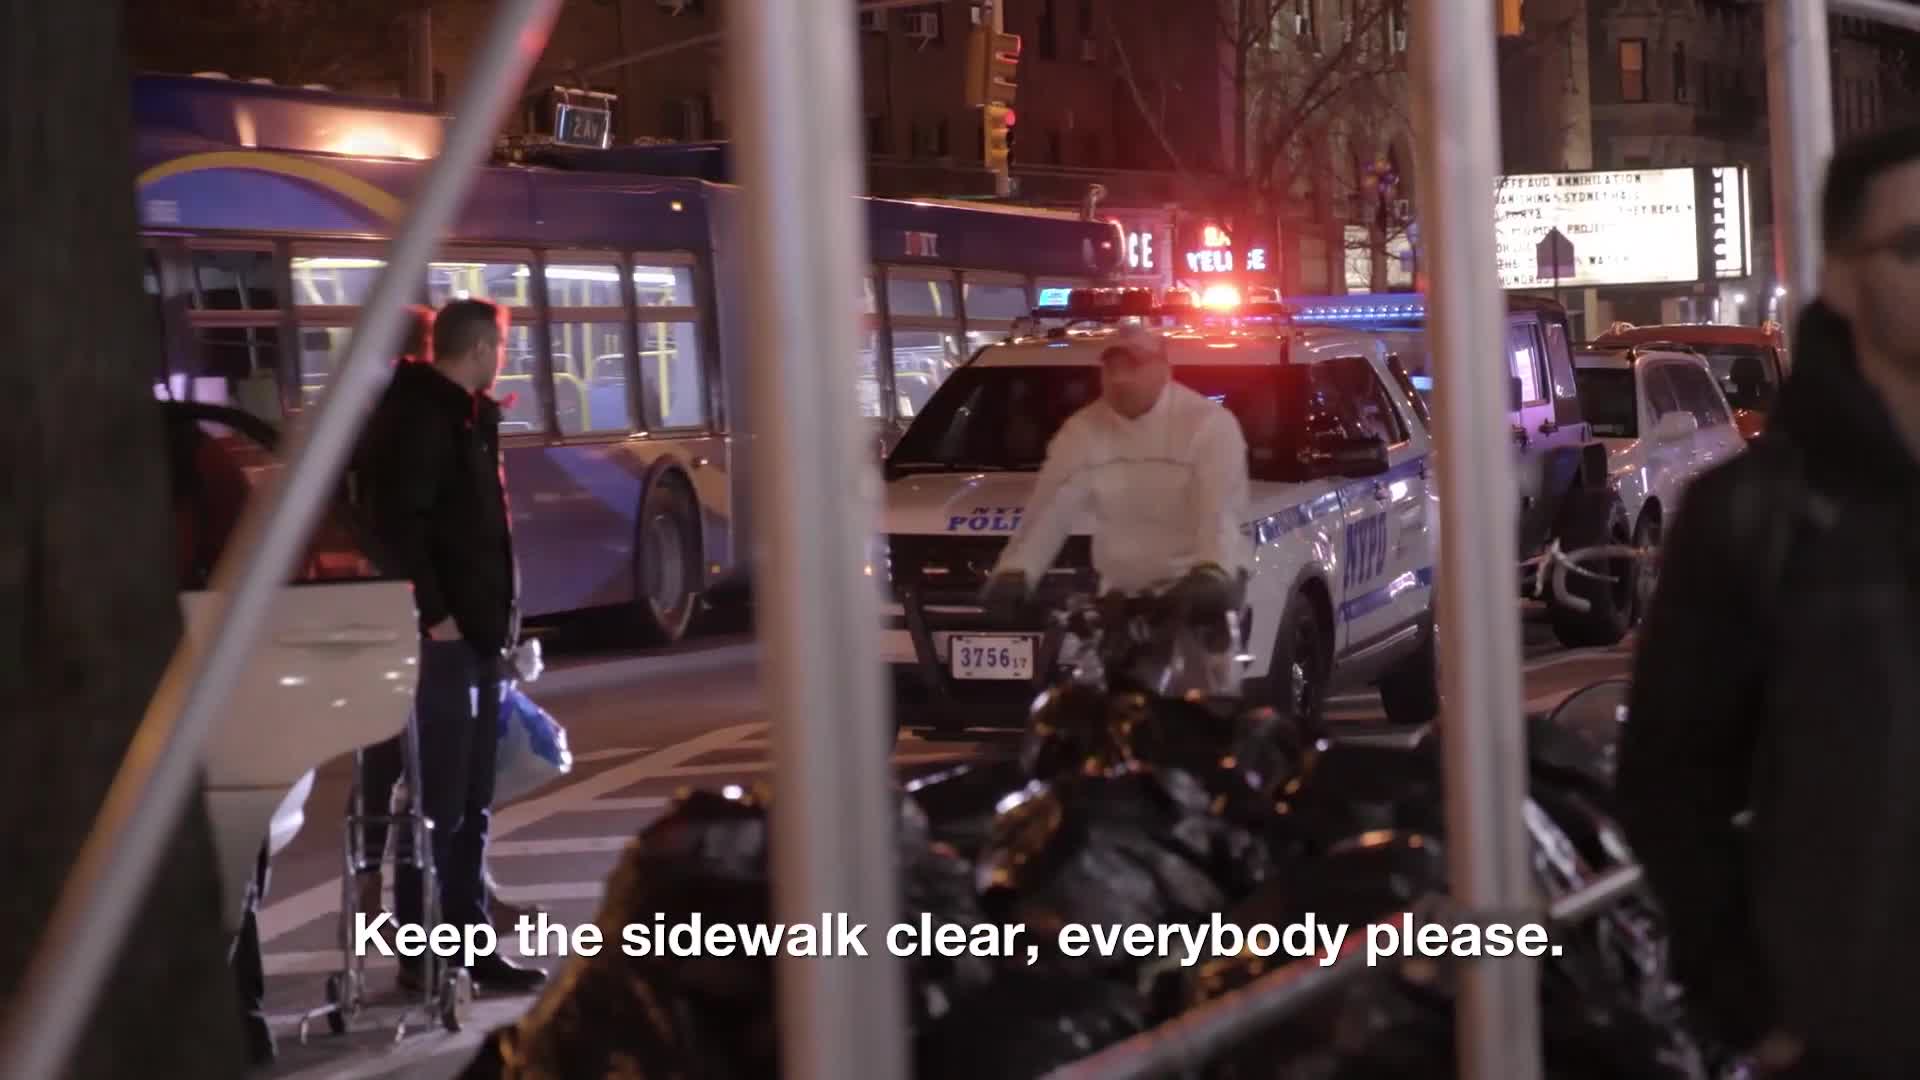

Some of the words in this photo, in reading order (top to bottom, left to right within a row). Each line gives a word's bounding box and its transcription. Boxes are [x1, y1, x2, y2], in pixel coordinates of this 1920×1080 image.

[1556, 174, 1642, 187] ANNIHILATION
[947, 516, 1021, 532] POLI
[1343, 511, 1387, 590] NYPD
[961, 647, 1010, 668] 3756
